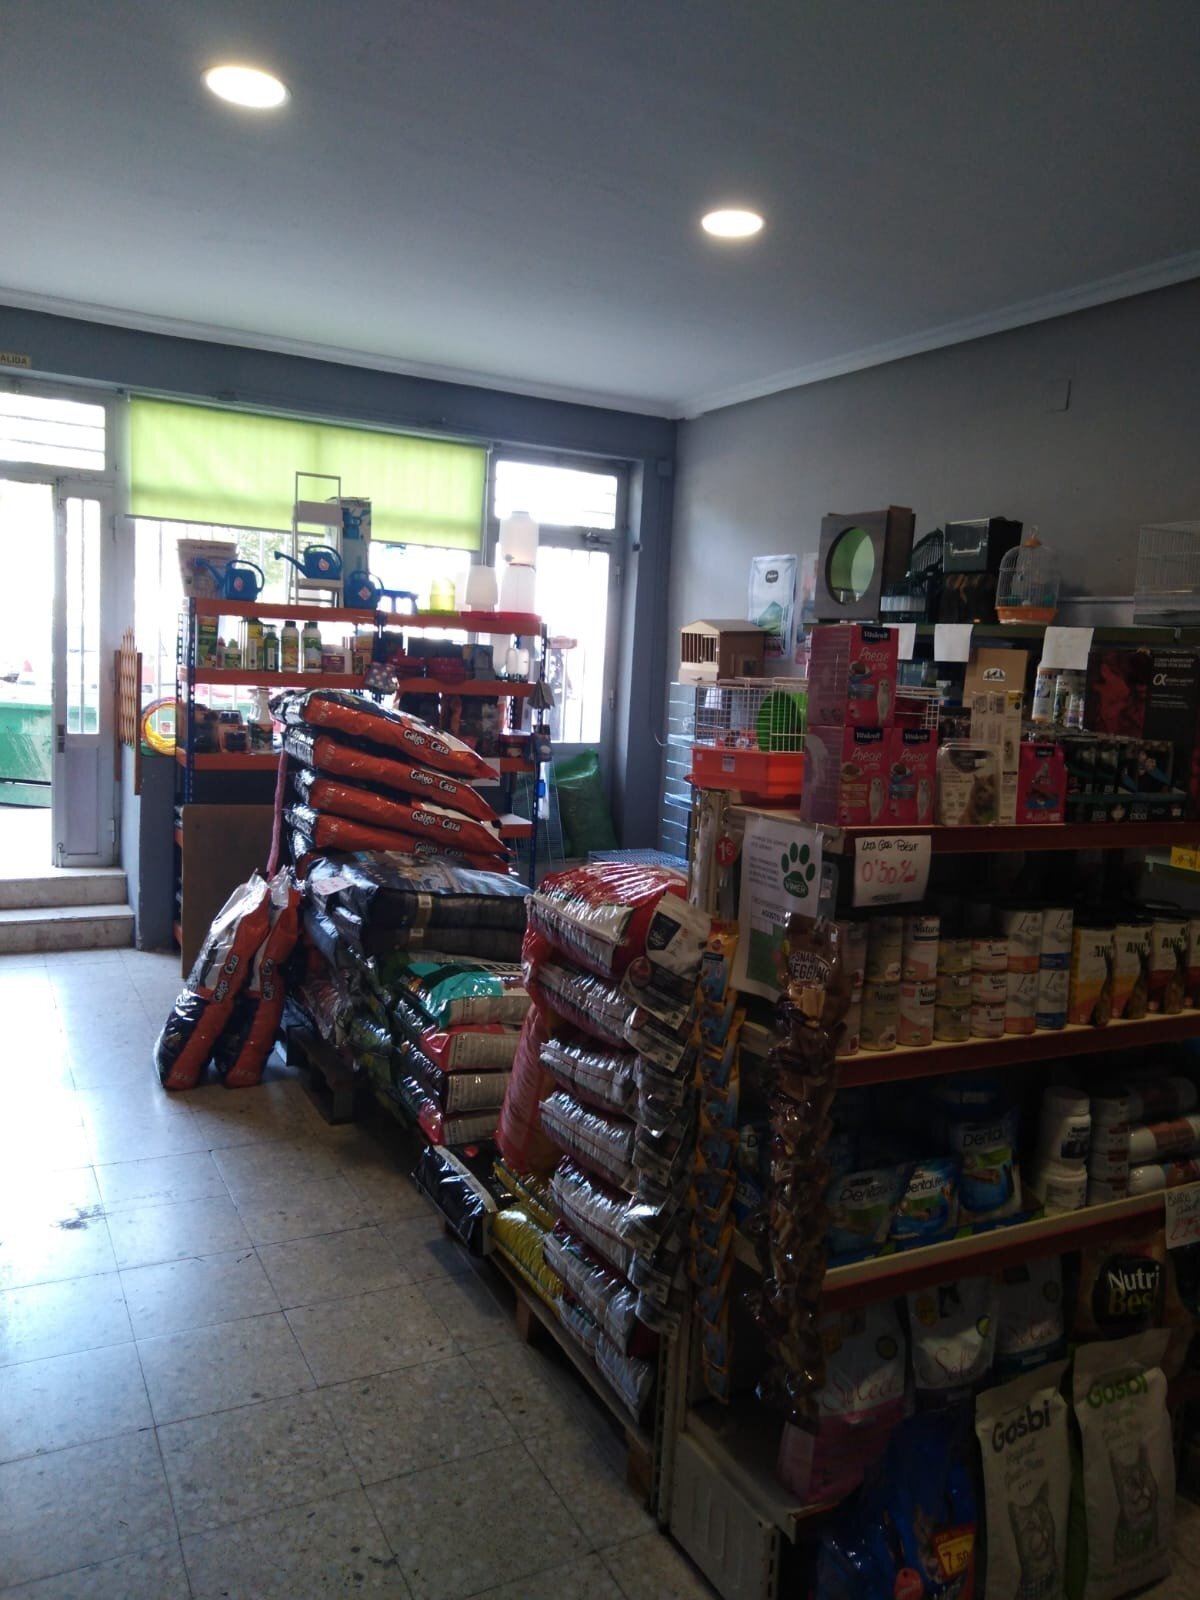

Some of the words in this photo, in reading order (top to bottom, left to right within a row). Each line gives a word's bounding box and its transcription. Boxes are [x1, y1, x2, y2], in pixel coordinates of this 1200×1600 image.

[0, 354, 27, 365] ALIDA
[1107, 1264, 1161, 1293] Nutri
[1086, 1374, 1148, 1409] Gosbi
[991, 1399, 1052, 1453] Gosbi
